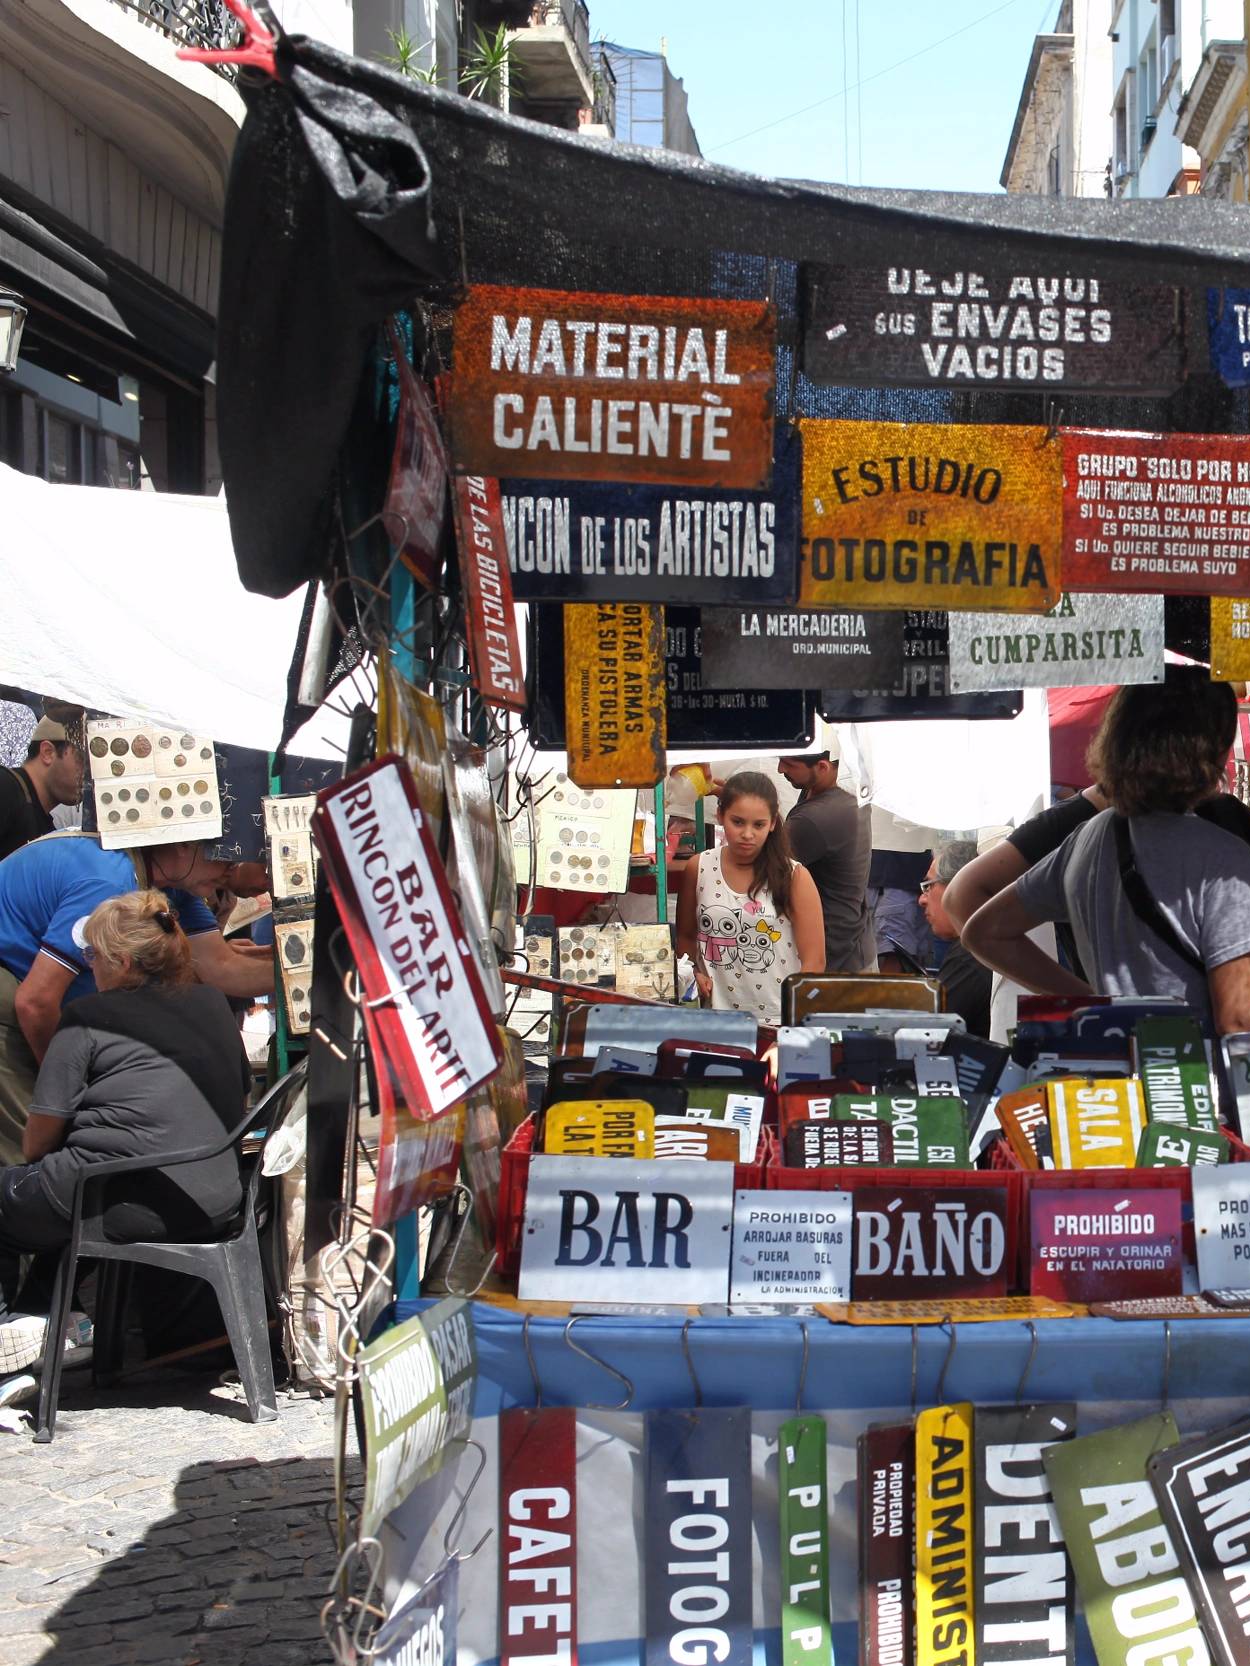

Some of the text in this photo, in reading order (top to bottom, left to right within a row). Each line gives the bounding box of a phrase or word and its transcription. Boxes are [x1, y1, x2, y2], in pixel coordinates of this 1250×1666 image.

[888, 267, 1099, 306] DEJE AQUI
[875, 302, 1112, 343] SUS ENVASES
[490, 315, 741, 385] MATERIAL
[921, 343, 1065, 381] VACIOS
[831, 456, 1002, 505] ESTUDIO
[1077, 454, 1232, 482] GRUPO POR
[1077, 480, 1100, 499] AQUI
[1104, 481, 1152, 501] FUNCIONA
[1157, 484, 1222, 504] ALCOHOLICOS
[908, 510, 927, 526] DE
[1103, 522, 1250, 541] ES PROBLEMA NUESTRO
[1119, 506, 1159, 522] DESEA
[1165, 508, 1205, 523] DEJAR
[1210, 510, 1227, 524] DE
[580, 502, 776, 578] DE LOS ARTISTAS
[1114, 541, 1158, 556] QUIERE
[1164, 543, 1209, 558] SEGUIR
[1111, 557, 1236, 575] ES PROBLEMA SUYO
[476, 553, 513, 693] BICICLETAS
[741, 613, 866, 637] LA MERCADERIA
[970, 628, 1144, 666] CUMPARSITA
[599, 656, 619, 755] PISTOLERA
[624, 671, 644, 734] ARMAS
[340, 781, 403, 931] RINCON
[389, 935, 427, 1006] DEL
[416, 1010, 472, 1096] ARTE
[396, 861, 455, 1000] BAR
[891, 1098, 920, 1164] DACTIL
[1076, 1088, 1123, 1151] SALA
[554, 1189, 694, 1269] BAR
[750, 1212, 836, 1224] PROHIBIDO
[1054, 1214, 1155, 1236] PROHIBIDO
[1221, 1222, 1246, 1240] MAS
[744, 1231, 843, 1245] ARROJAR BASURAS
[1040, 1246, 1172, 1259] ESCUPIR ORINAR
[753, 1270, 821, 1282] INCINERADOR
[758, 1251, 832, 1264] FUERA DEL
[1047, 1259, 1165, 1271] EN NATATORIO
[873, 1469, 887, 1537] PRIVADA
[888, 1462, 903, 1538] PROPIEDAD
[666, 1478, 731, 1666] FOTOG
